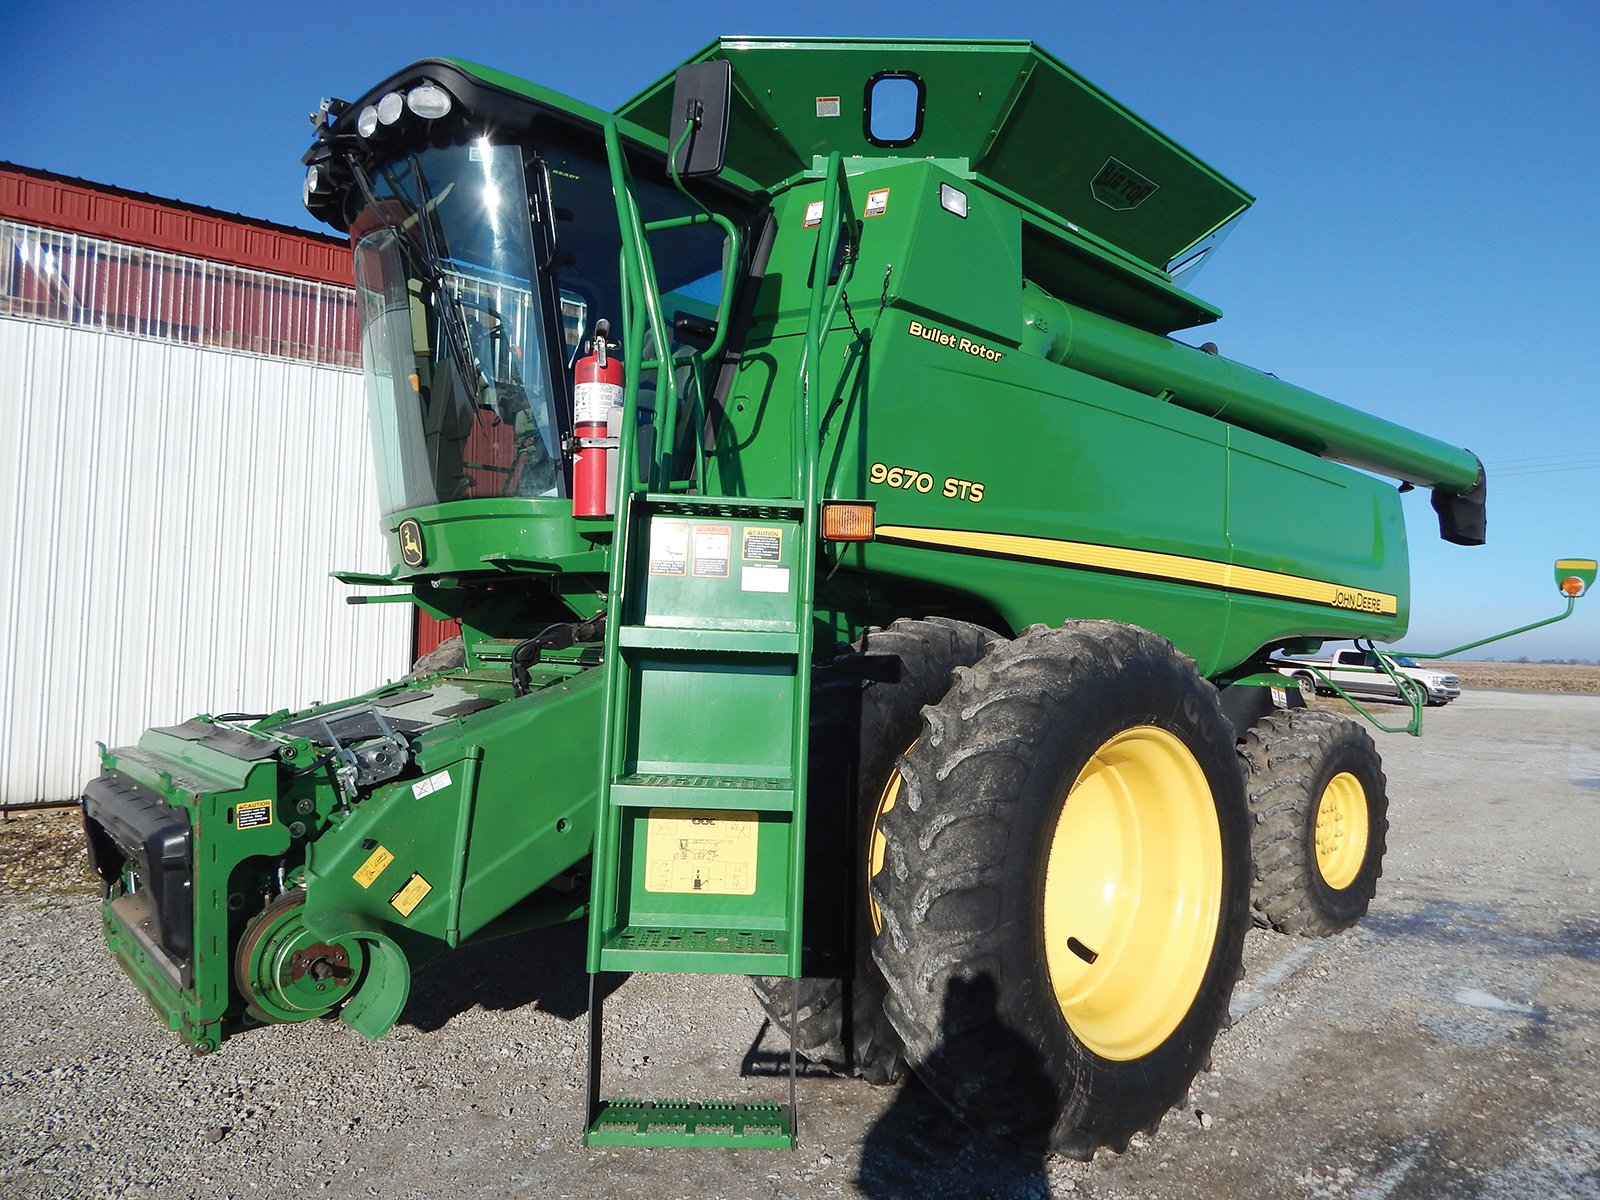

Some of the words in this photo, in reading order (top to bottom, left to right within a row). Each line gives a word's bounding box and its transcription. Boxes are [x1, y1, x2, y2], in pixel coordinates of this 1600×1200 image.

[552, 169, 581, 180] READY
[908, 320, 957, 349] Bullet
[958, 337, 1003, 363] Rotor
[869, 461, 935, 495] 9670
[942, 476, 986, 504] STS
[1332, 588, 1356, 607] JOHN
[1356, 592, 1381, 611] DEERE
[243, 801, 270, 809] CAUTION
